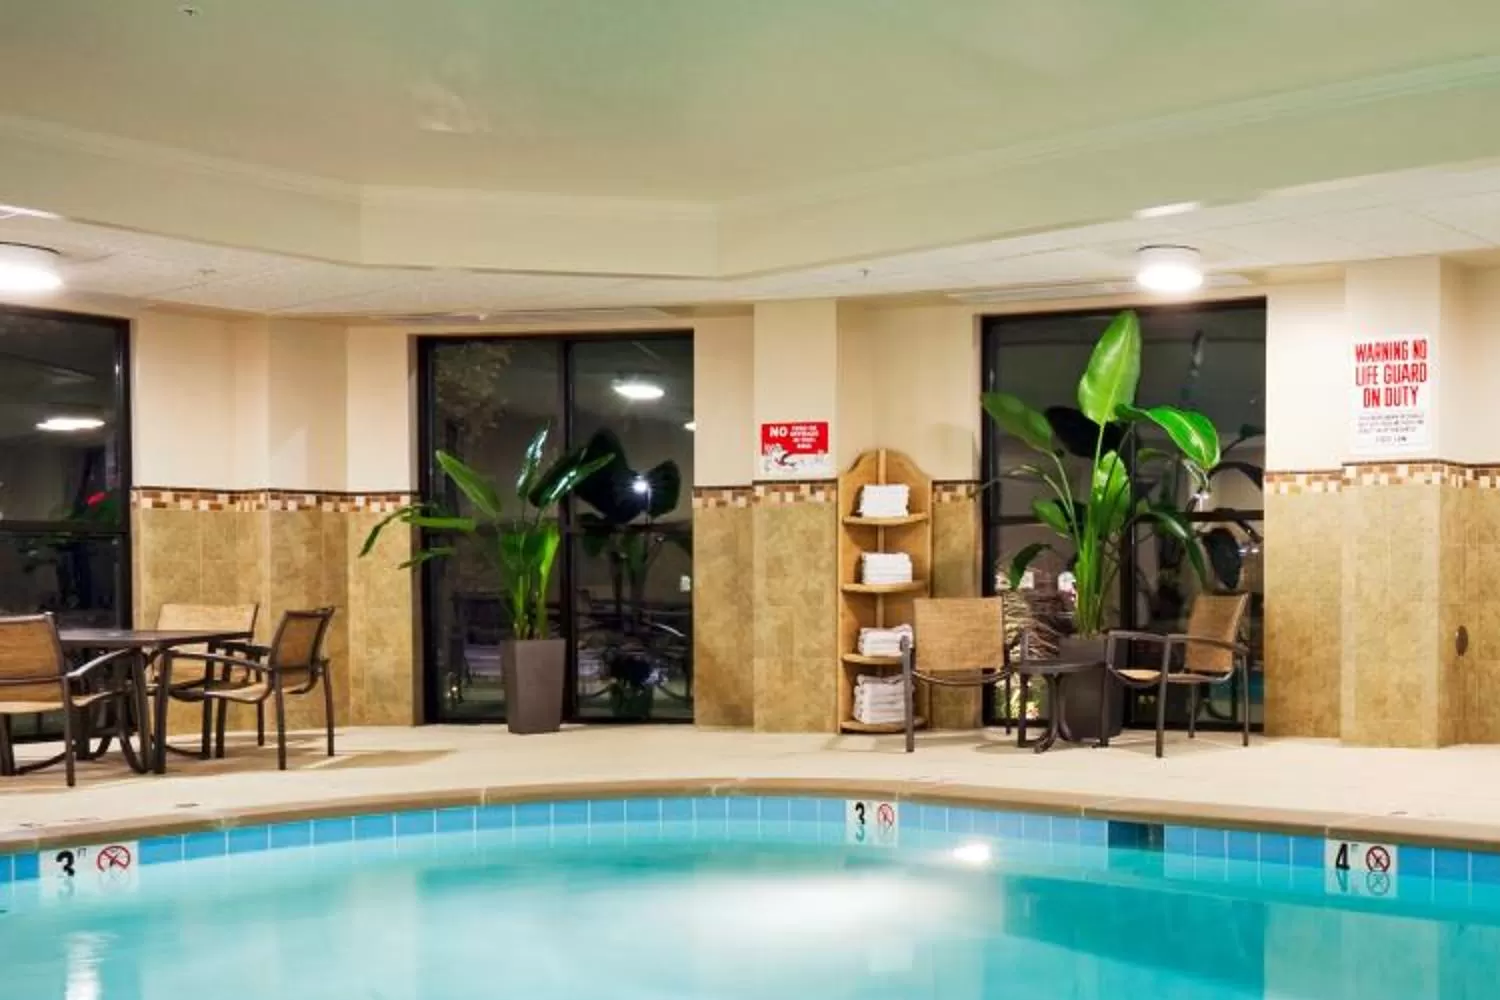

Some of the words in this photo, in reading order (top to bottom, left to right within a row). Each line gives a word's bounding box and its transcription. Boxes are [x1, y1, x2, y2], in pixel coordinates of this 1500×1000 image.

[1355, 341, 1408, 362] WARNING
[1413, 339, 1427, 359] NO
[1355, 365, 1379, 386] LIFE
[1383, 362, 1427, 384] GUARD
[1363, 387, 1380, 408] ON
[1384, 385, 1419, 407] DUTY
[769, 425, 788, 438] NO
[855, 802, 865, 825] 3
[56, 850, 75, 877] 3
[1336, 843, 1350, 871] 4
